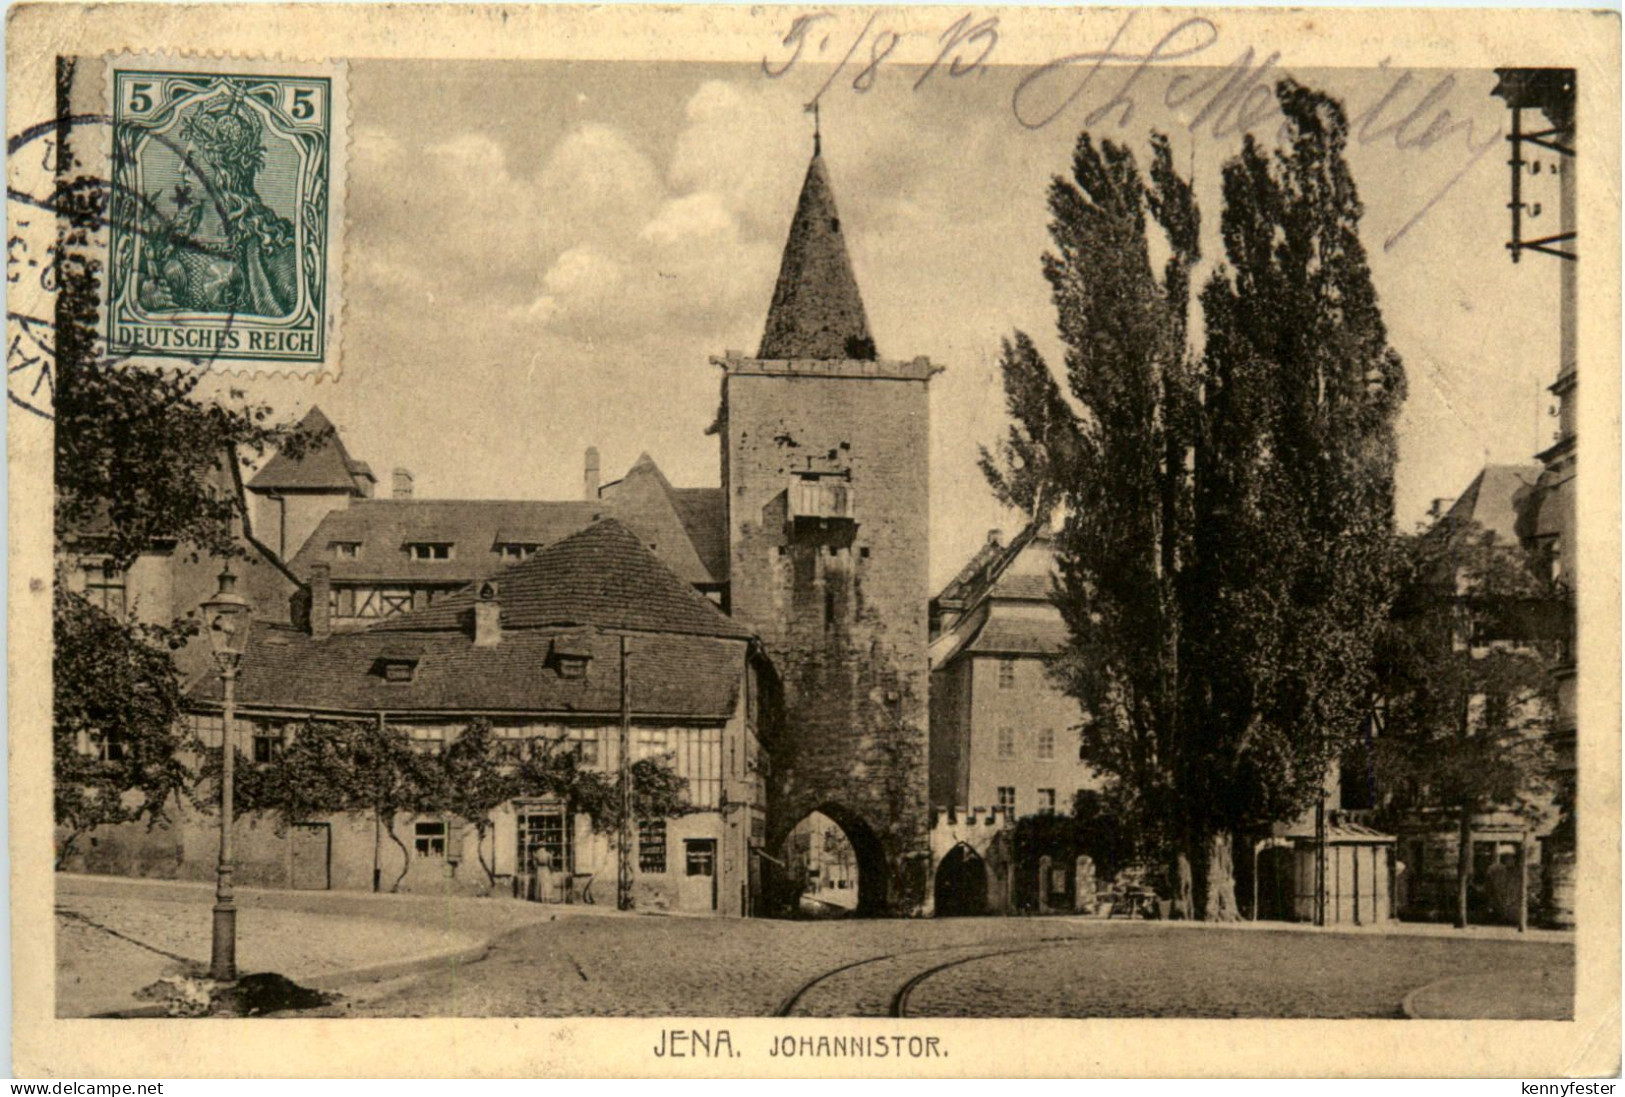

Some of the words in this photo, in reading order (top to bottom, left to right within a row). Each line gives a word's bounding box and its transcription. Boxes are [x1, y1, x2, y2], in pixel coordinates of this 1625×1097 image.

[129, 83, 153, 113] 5
[291, 89, 315, 119] 5
[118, 326, 240, 349] DEUTSCHES
[248, 330, 315, 352] REICH
[653, 1029, 741, 1058] JENA.
[769, 1036, 949, 1058] JOHANNISTOR.
